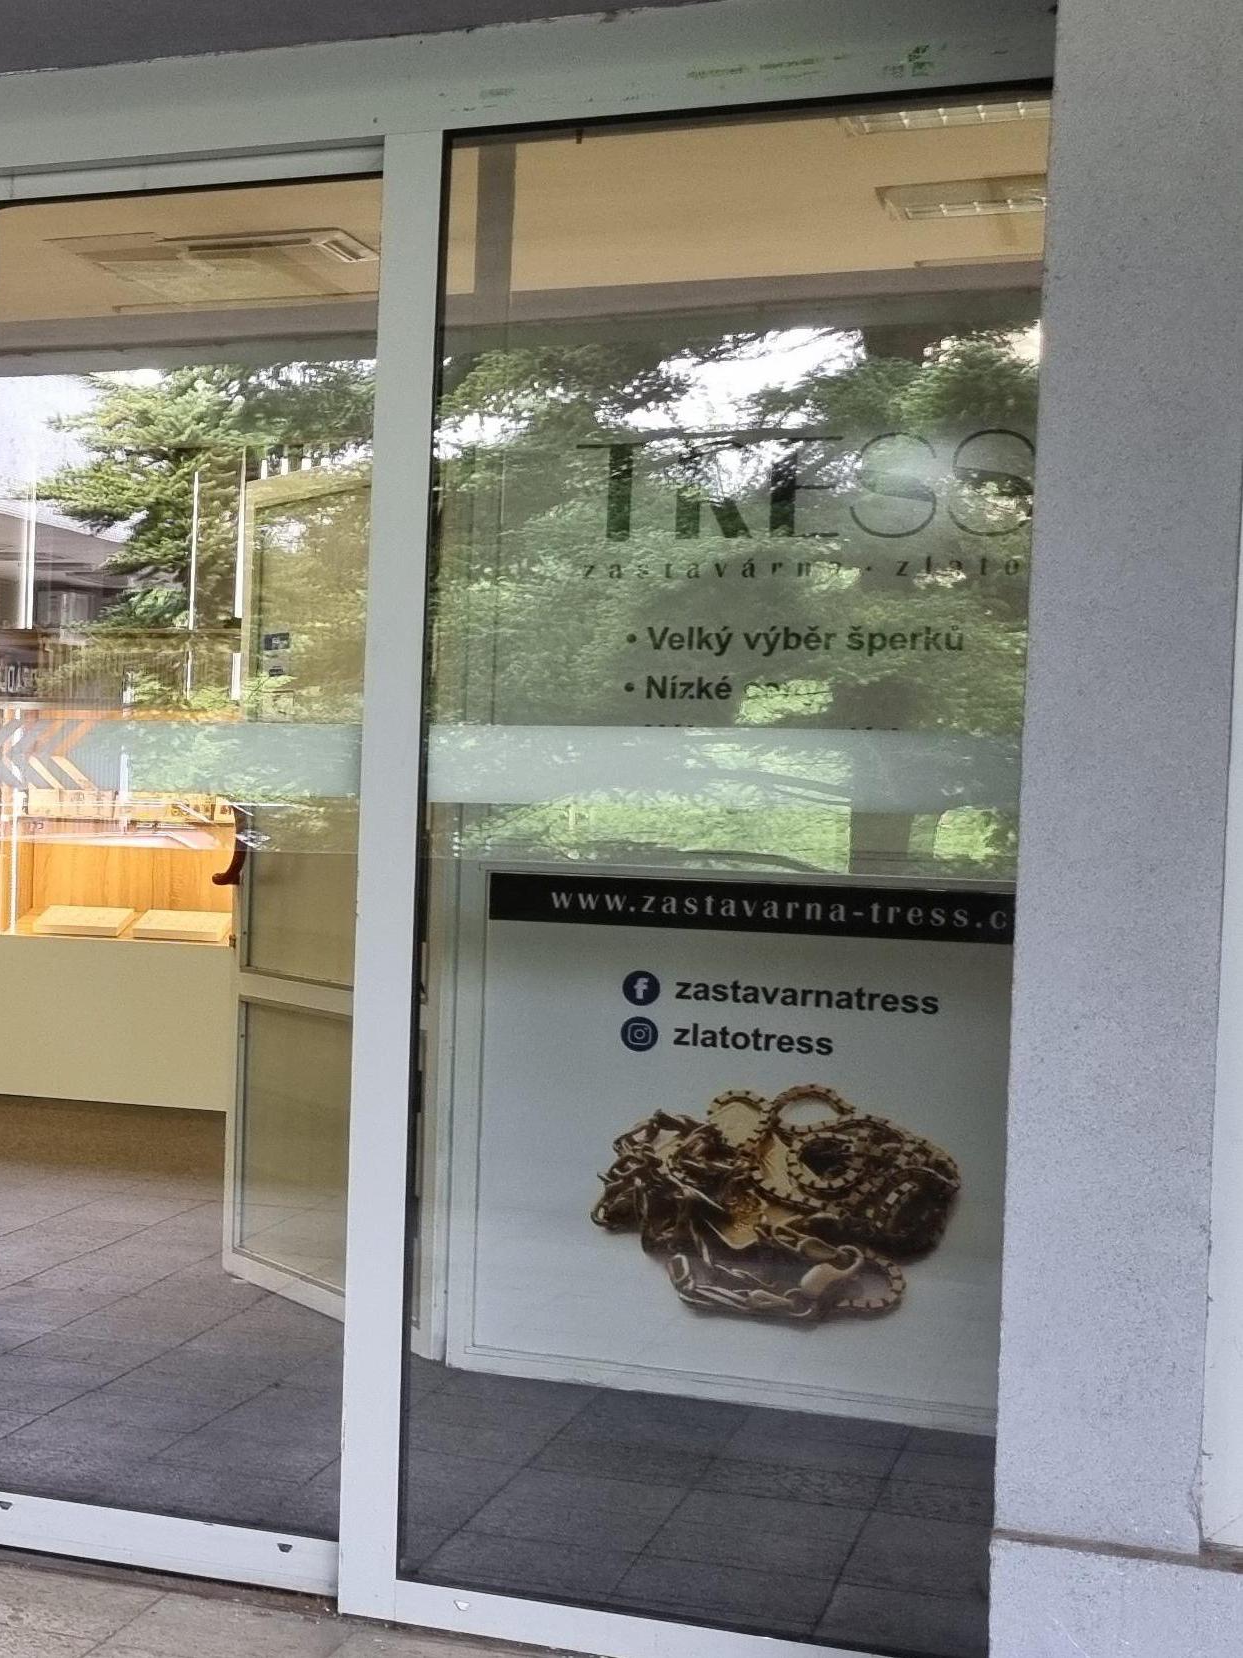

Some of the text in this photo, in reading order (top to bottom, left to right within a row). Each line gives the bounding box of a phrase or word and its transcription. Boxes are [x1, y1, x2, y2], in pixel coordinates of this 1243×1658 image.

[576, 428, 1036, 543] TRESS
[582, 556, 1022, 580] zastavárna zlato
[646, 623, 965, 657] Velký výběr šperků
[645, 675, 733, 701] Nízké
[550, 888, 1014, 932] www.zastavarna-tress.c
[674, 976, 940, 1017] zastavarnatress
[672, 1022, 835, 1057] zlatotress
